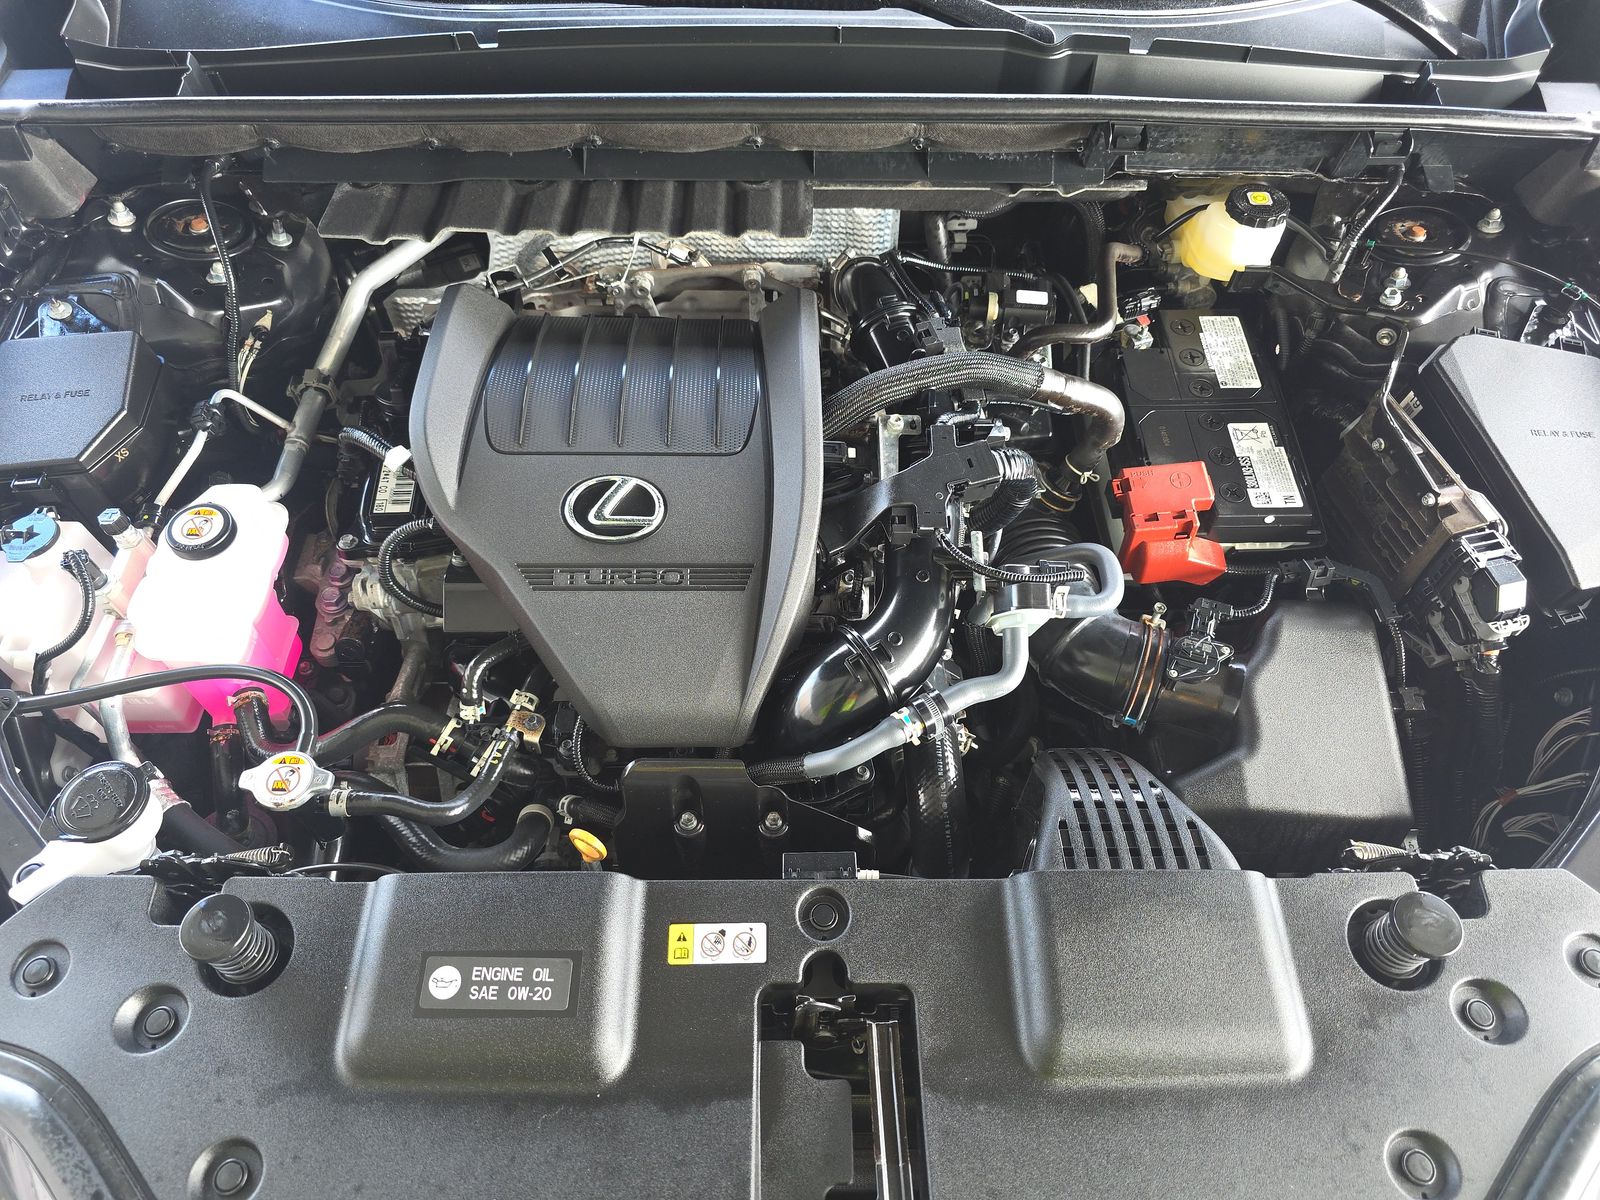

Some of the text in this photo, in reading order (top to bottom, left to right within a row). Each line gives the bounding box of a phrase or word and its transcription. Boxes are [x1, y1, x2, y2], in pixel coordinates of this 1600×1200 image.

[20, 389, 90, 402] RELAY & FUSE
[1530, 429, 1560, 437] RELAY
[114, 447, 129, 463] XS
[559, 568, 684, 586] TURBO
[471, 966, 555, 982] ENGINE OIL
[469, 985, 552, 1001] SAE 0W-20
